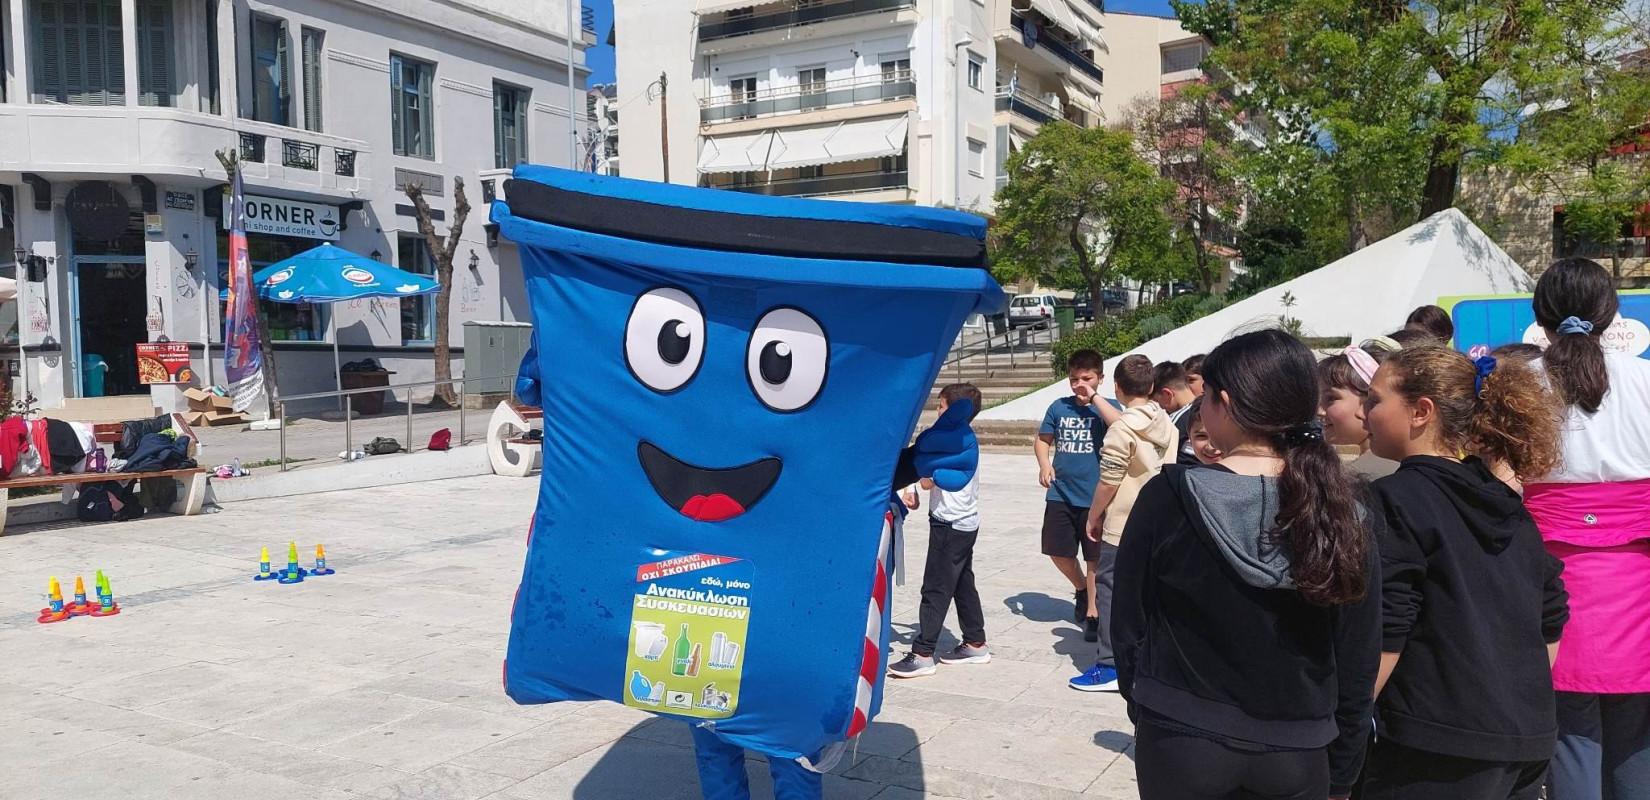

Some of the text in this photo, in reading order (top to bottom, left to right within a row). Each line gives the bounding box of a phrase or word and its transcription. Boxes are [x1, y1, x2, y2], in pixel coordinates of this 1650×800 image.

[243, 201, 316, 226] ORNER
[253, 222, 273, 232] shop
[275, 224, 290, 234] and
[291, 227, 316, 236] coffee
[1059, 416, 1095, 429] NEXT
[1057, 429, 1093, 441] LEVEL
[1057, 441, 1094, 453] SKILLS
[641, 557, 721, 581] ΟΧΙ ΣΚΟΥΠΙΔΙΑ!
[701, 577, 751, 589] εδώ, μόνο
[646, 583, 748, 606] Ανακύκλωση
[636, 595, 747, 620] Συσκευασιών
